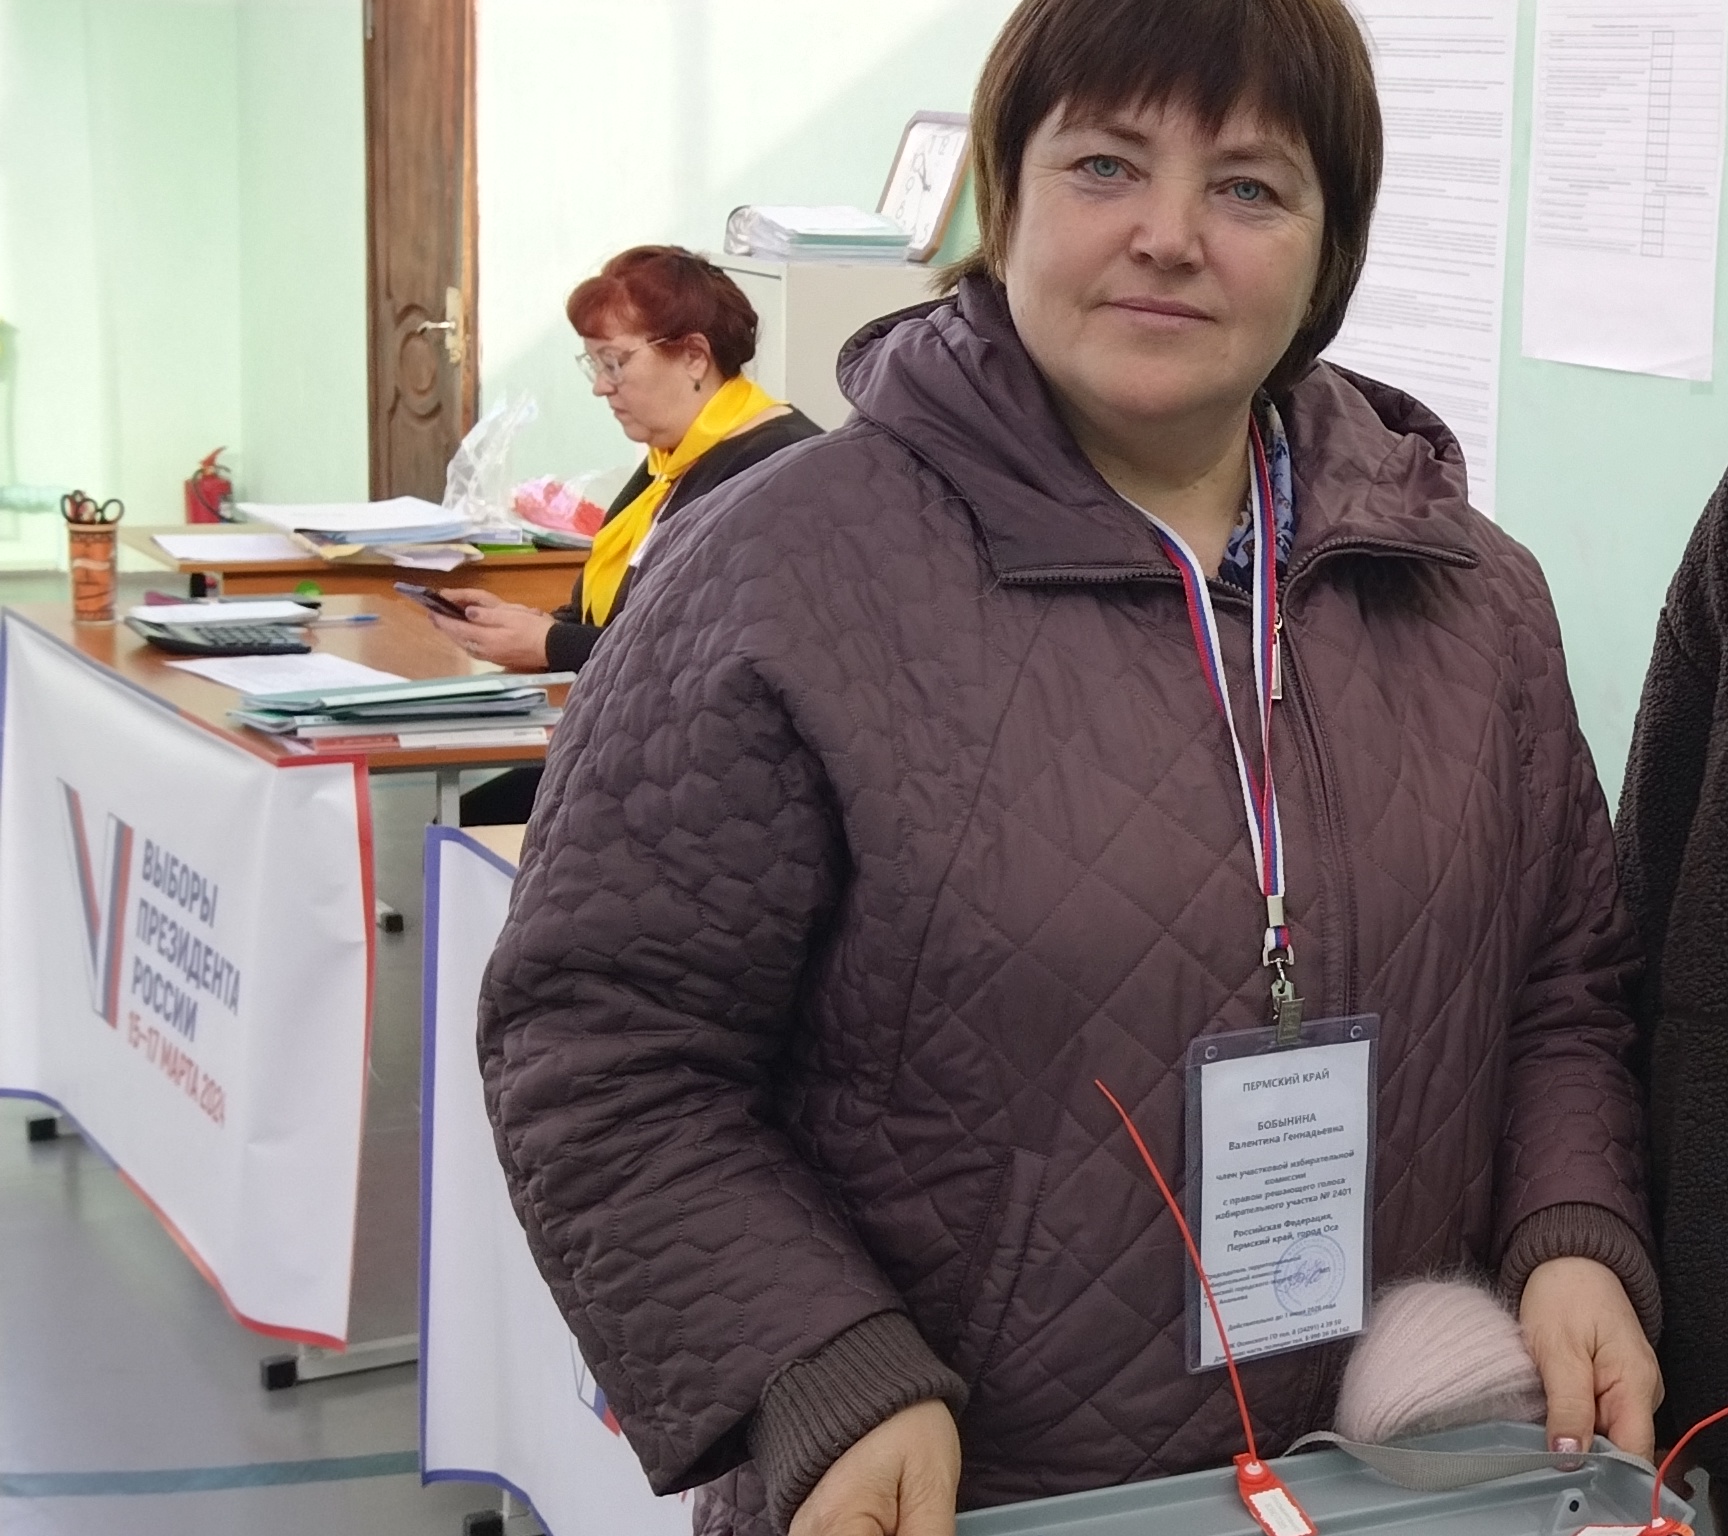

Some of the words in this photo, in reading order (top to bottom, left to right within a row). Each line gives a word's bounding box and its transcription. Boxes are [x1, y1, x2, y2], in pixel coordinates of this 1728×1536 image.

[141, 837, 218, 928] ВЫБОРЫ
[135, 897, 240, 1016] ПРЕЗИДЕНТА
[131, 955, 198, 1042] РОССИИ
[160, 1036, 199, 1104] МАРТА
[199, 1072, 227, 1128] 2024
[1243, 1073, 1300, 1092] ПЕРМСКИЙ
[1302, 1068, 1330, 1083] КРАЙ
[1258, 1113, 1317, 1130] БОБЫНИНА
[1229, 1135, 1280, 1151] Валентина
[1283, 1125, 1345, 1142] Геннадьевна
[1290, 1150, 1355, 1169] избирательной
[1227, 1237, 1270, 1252] Пермский
